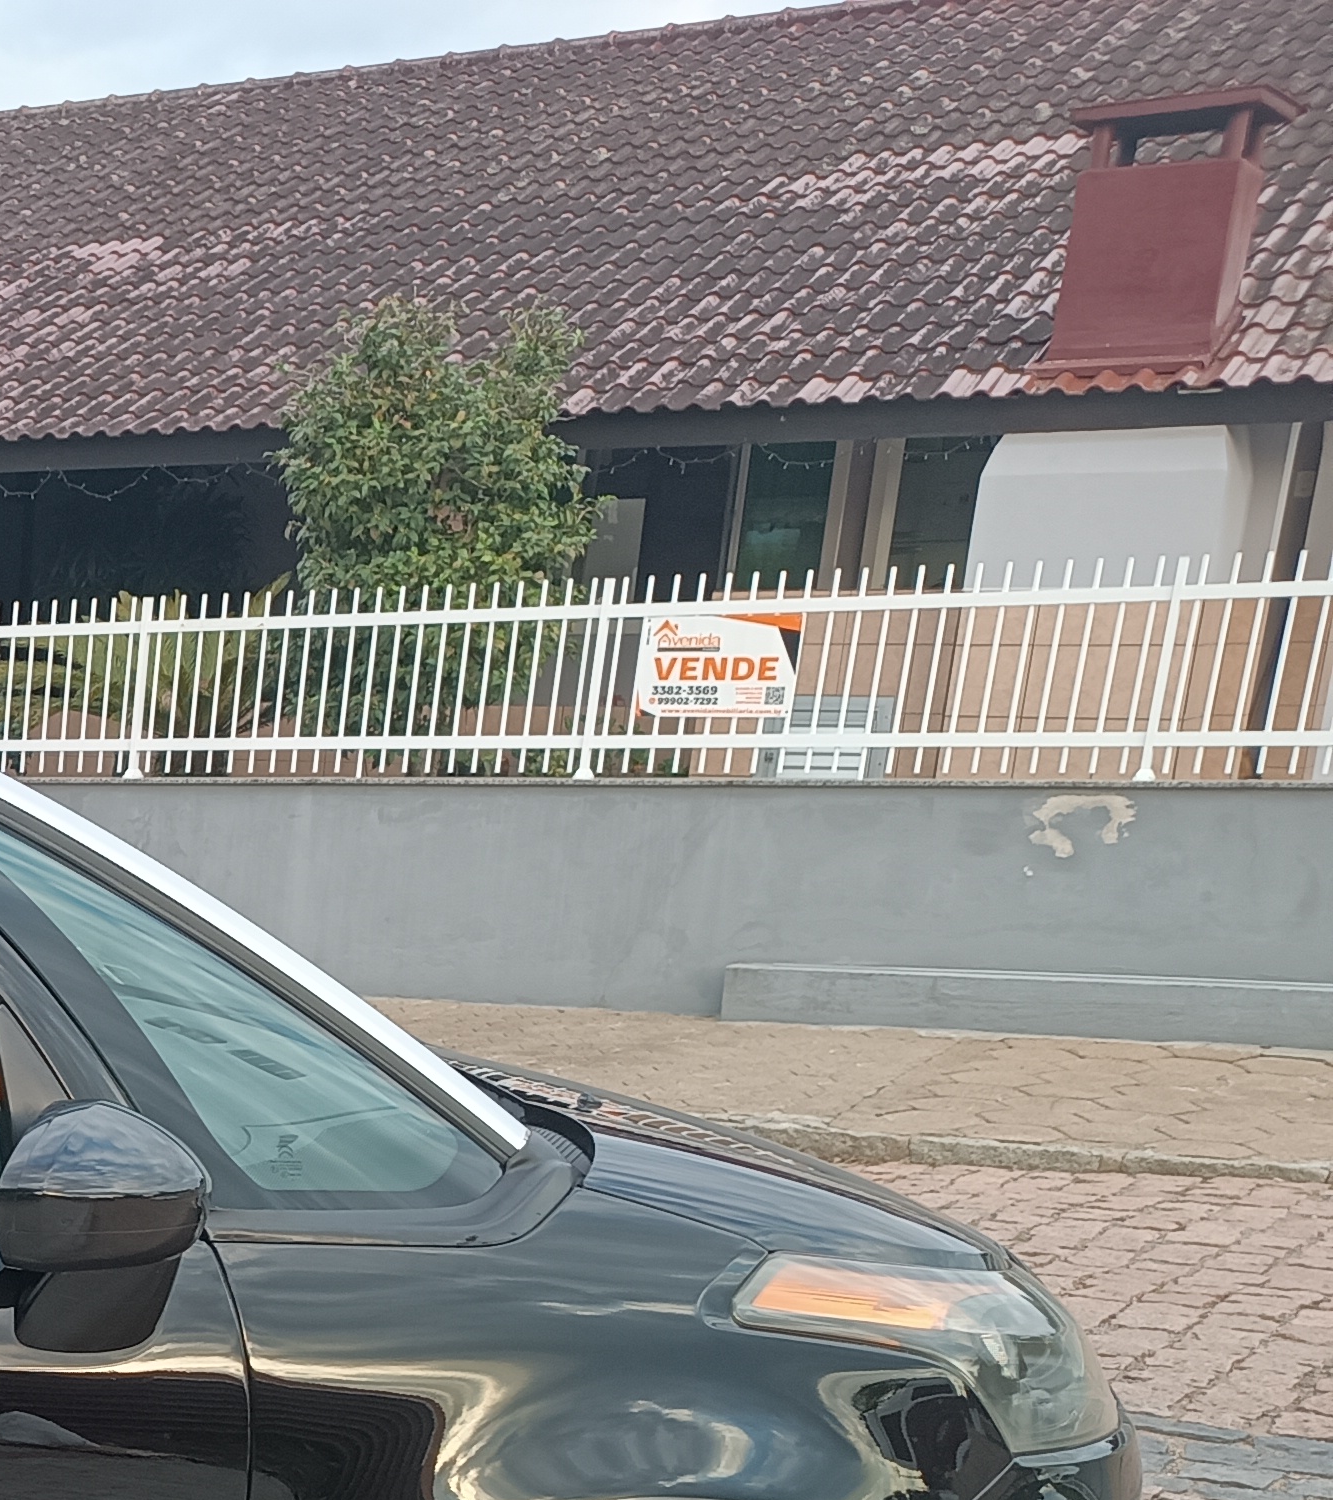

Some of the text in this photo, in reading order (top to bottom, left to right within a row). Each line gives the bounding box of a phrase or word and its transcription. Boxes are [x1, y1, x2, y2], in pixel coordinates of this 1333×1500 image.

[658, 632, 721, 648] Avenida
[653, 656, 780, 681] VENDE
[651, 685, 718, 696] 3382-3569
[657, 697, 719, 706] 99902-7292
